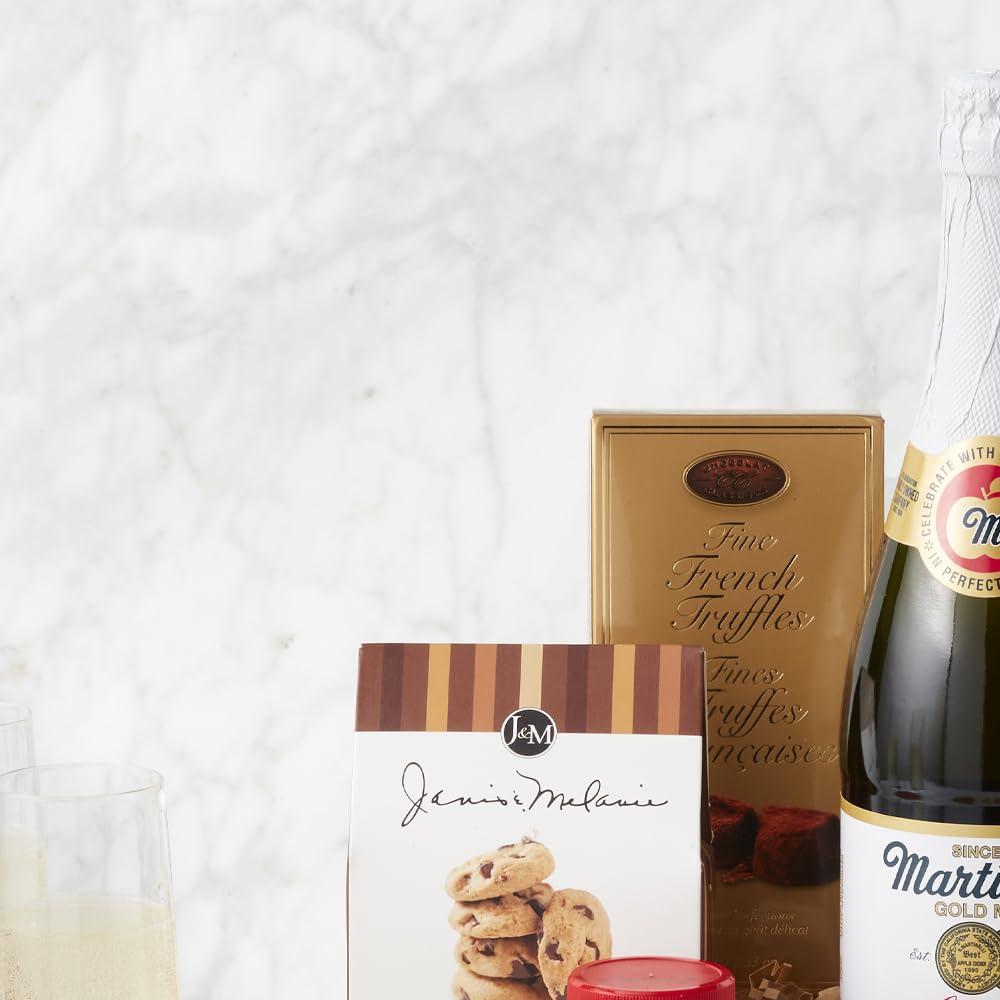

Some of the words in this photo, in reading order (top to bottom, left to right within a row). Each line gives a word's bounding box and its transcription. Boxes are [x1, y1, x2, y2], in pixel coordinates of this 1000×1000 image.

[921, 459, 956, 537] CELEBRATE
[958, 446, 996, 464] WITH
[703, 522, 778, 551] Fine
[666, 554, 804, 591] French
[928, 552, 941, 568] IN
[671, 593, 817, 644] Truffles
[706, 656, 784, 686] Fines
[507, 715, 555, 746] J&M
[709, 735, 840, 773] nçaises
[934, 901, 988, 918] GOLD
[909, 947, 930, 962] Est.
